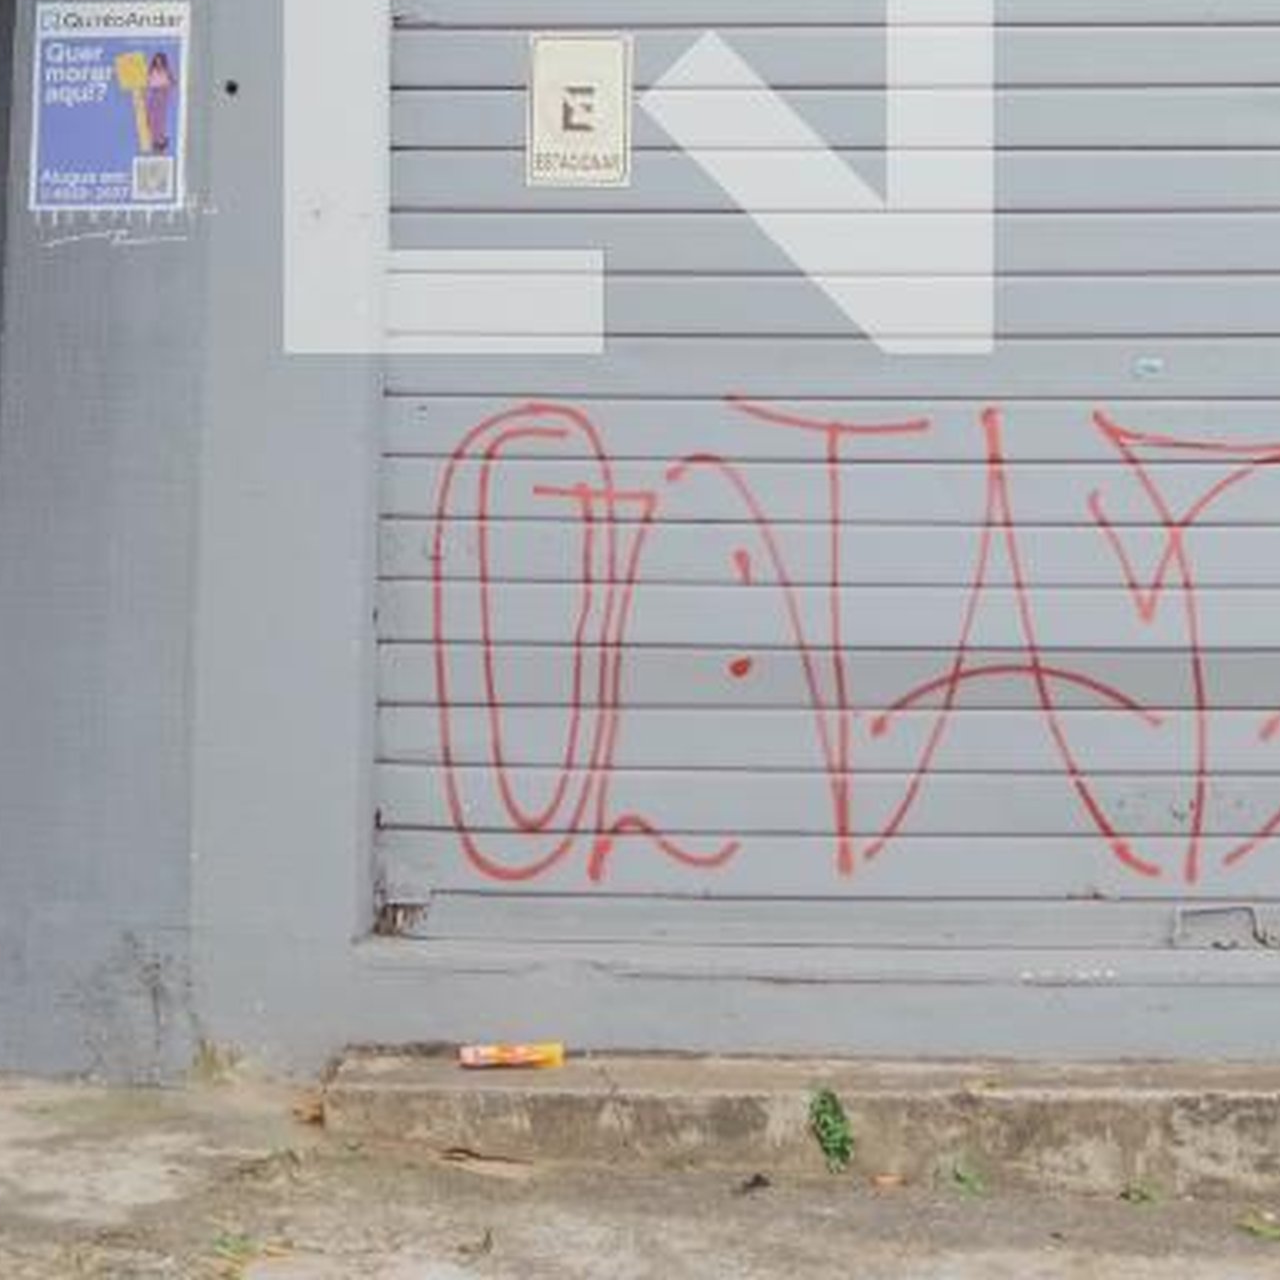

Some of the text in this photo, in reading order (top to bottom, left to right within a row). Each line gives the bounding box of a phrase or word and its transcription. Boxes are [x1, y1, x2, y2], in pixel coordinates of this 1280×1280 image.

[62, 12, 185, 30] QuintoAndar
[45, 42, 105, 63] Quer
[45, 65, 112, 82] morar
[45, 82, 108, 107] aqui?
